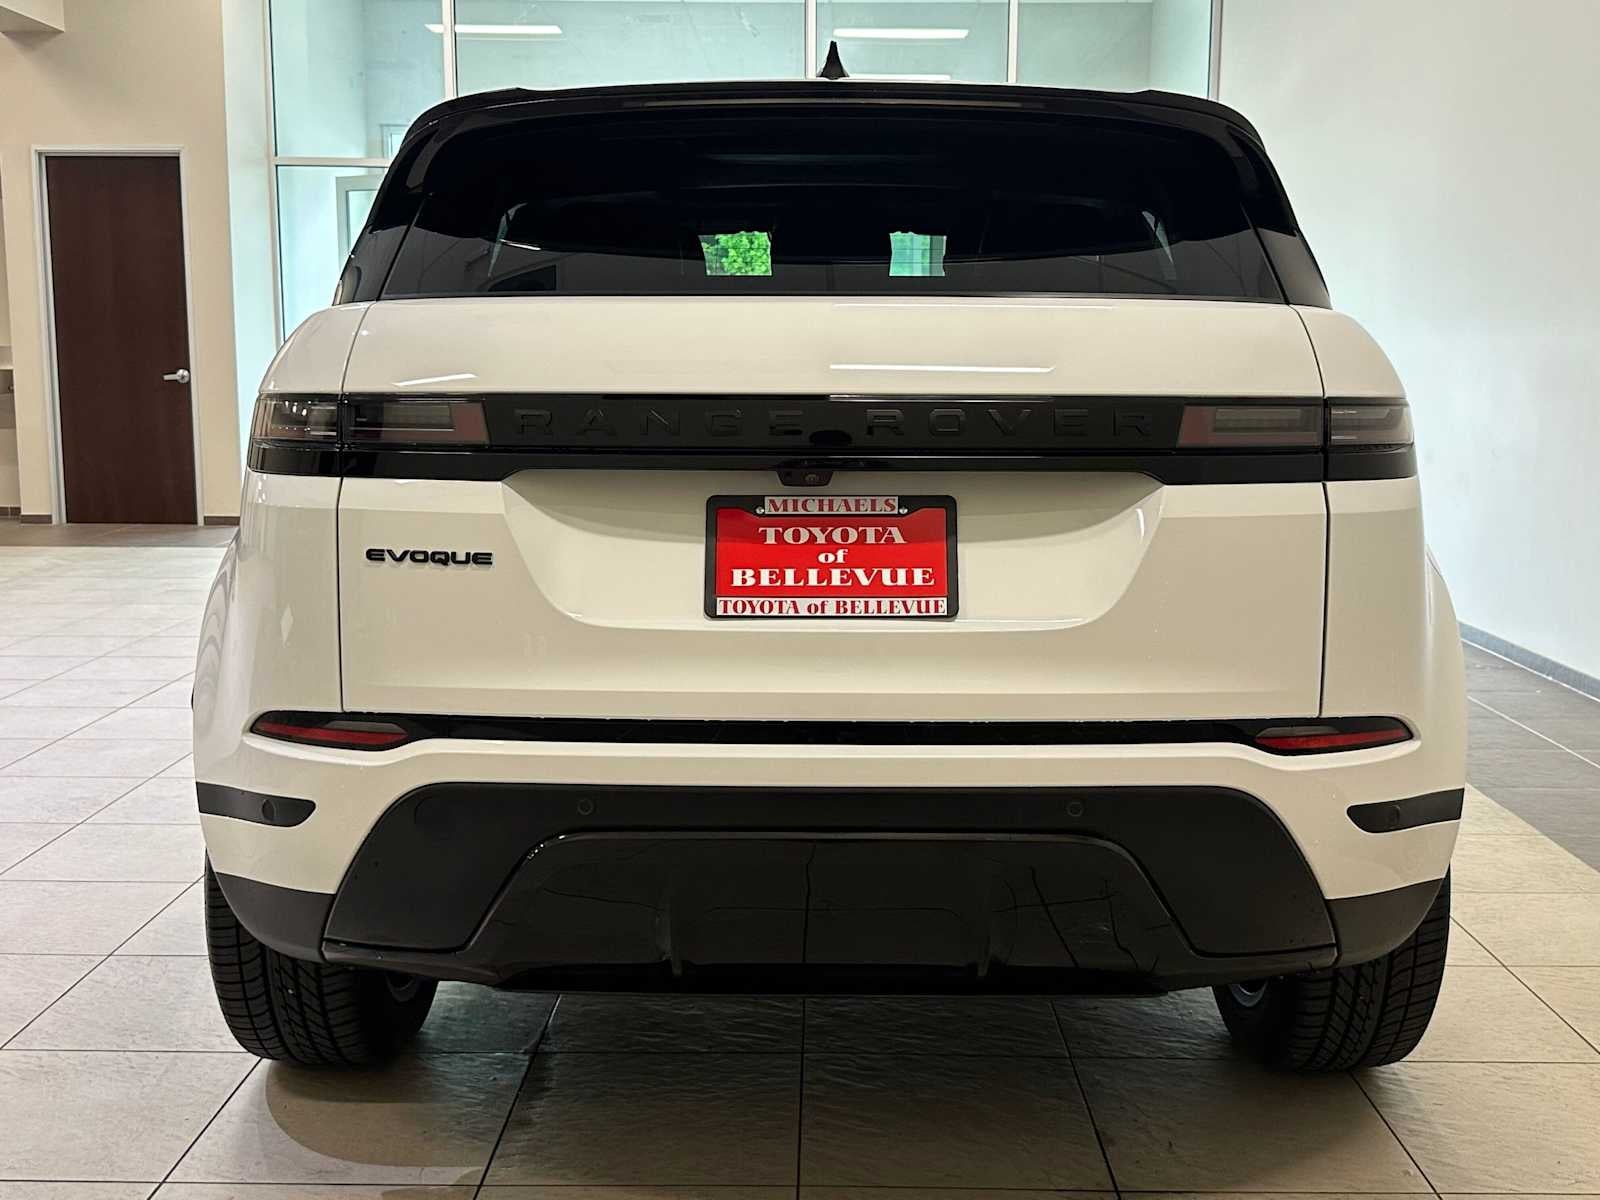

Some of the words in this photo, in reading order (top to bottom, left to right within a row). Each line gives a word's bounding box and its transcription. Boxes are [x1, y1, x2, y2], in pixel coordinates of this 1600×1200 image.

[514, 408, 803, 436] RANGE
[864, 408, 1150, 436] ROVER
[767, 498, 897, 513] MICHAELS
[758, 526, 907, 545] TOYOTA
[365, 548, 493, 566] EVOQUE
[817, 548, 849, 564] of
[731, 567, 935, 587] BELLEVUE
[719, 600, 800, 615] TOYOTA
[807, 600, 829, 615] of
[835, 600, 946, 615] BELLEVUE
